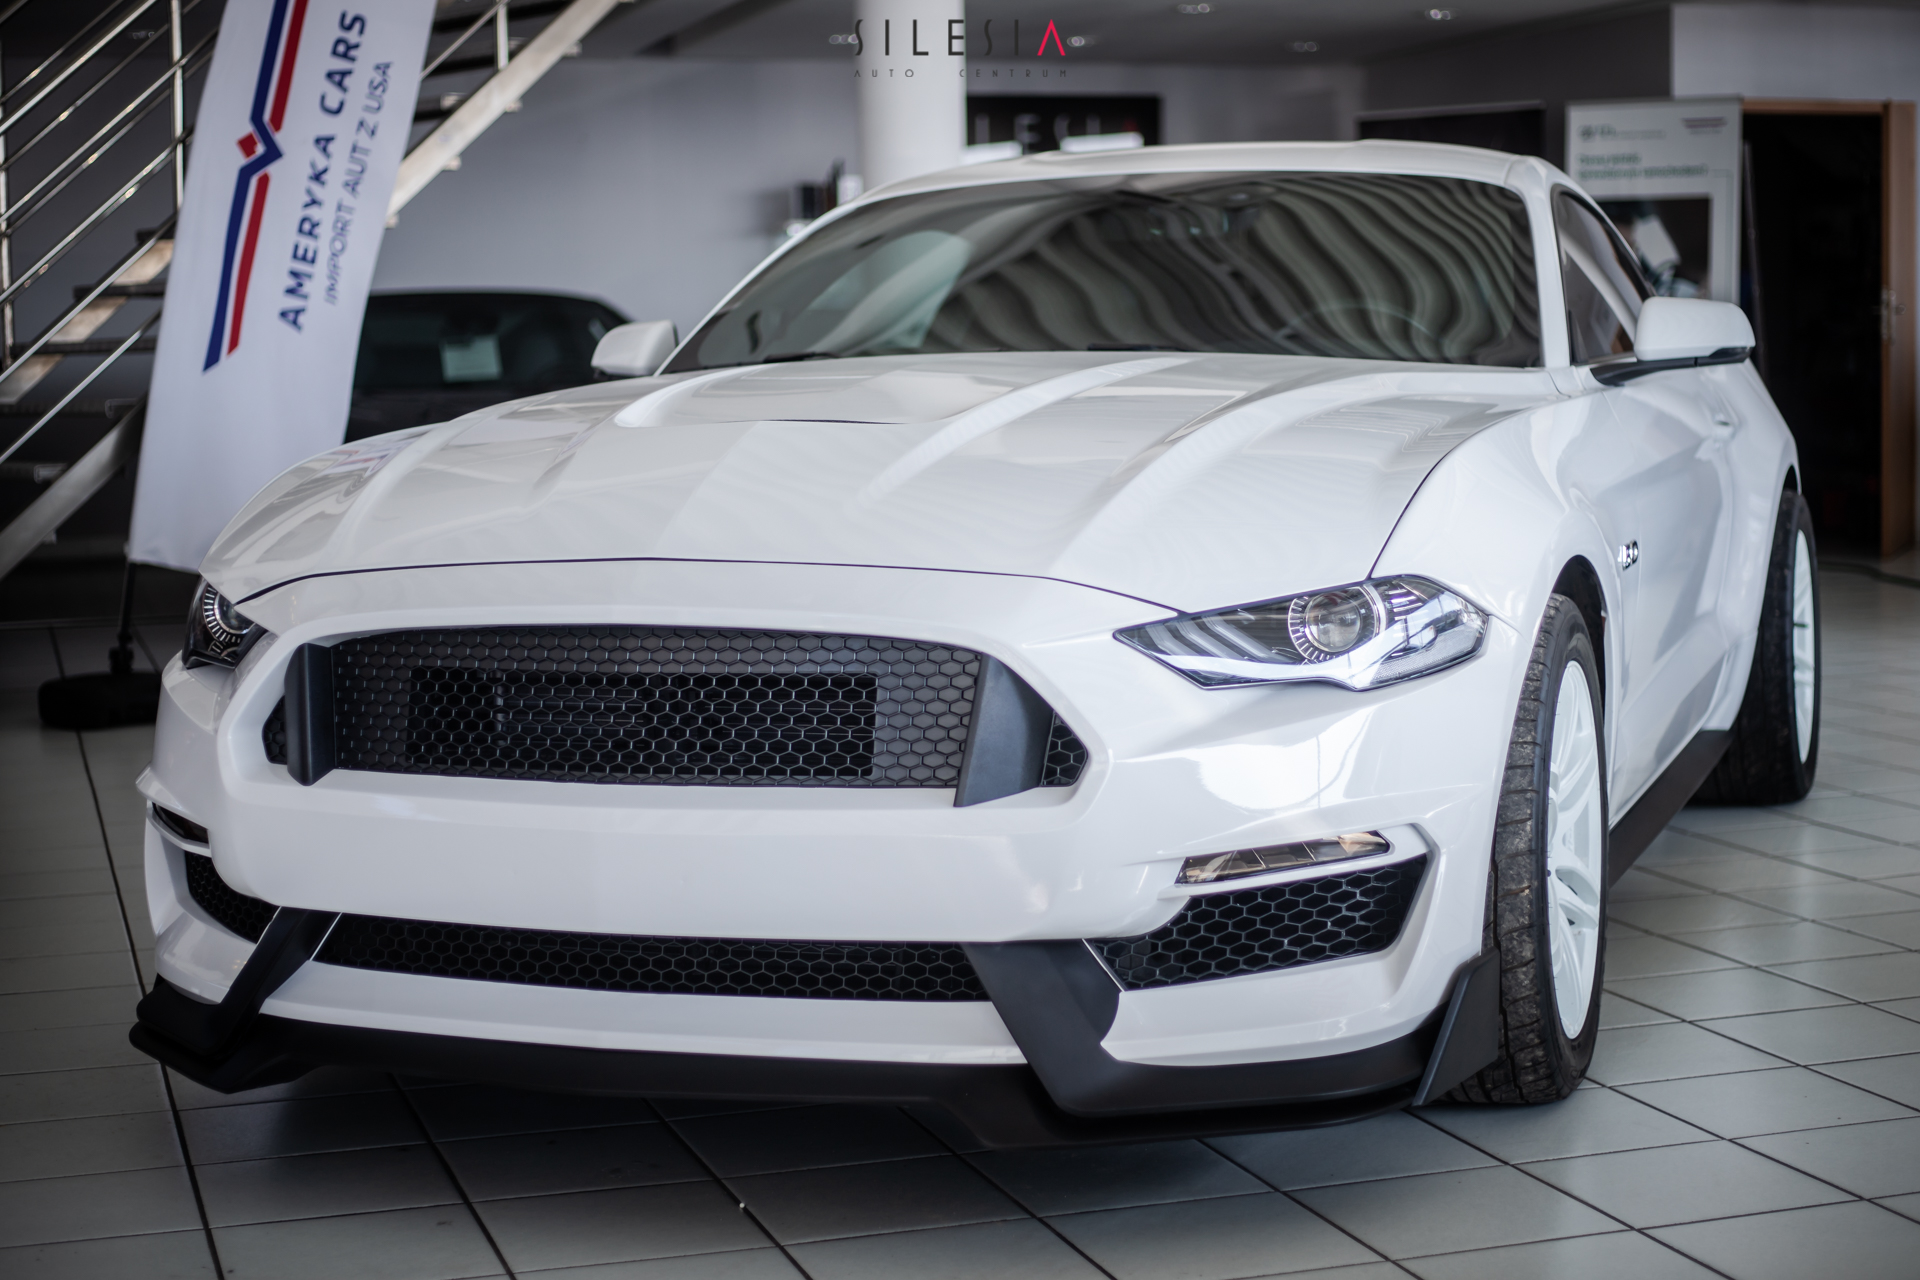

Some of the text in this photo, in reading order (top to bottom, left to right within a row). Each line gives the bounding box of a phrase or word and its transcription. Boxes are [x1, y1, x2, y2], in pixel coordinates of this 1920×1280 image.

[279, 10, 367, 333] AMERYKA CARS
[324, 60, 394, 306] IMPORT AUT Z USA
